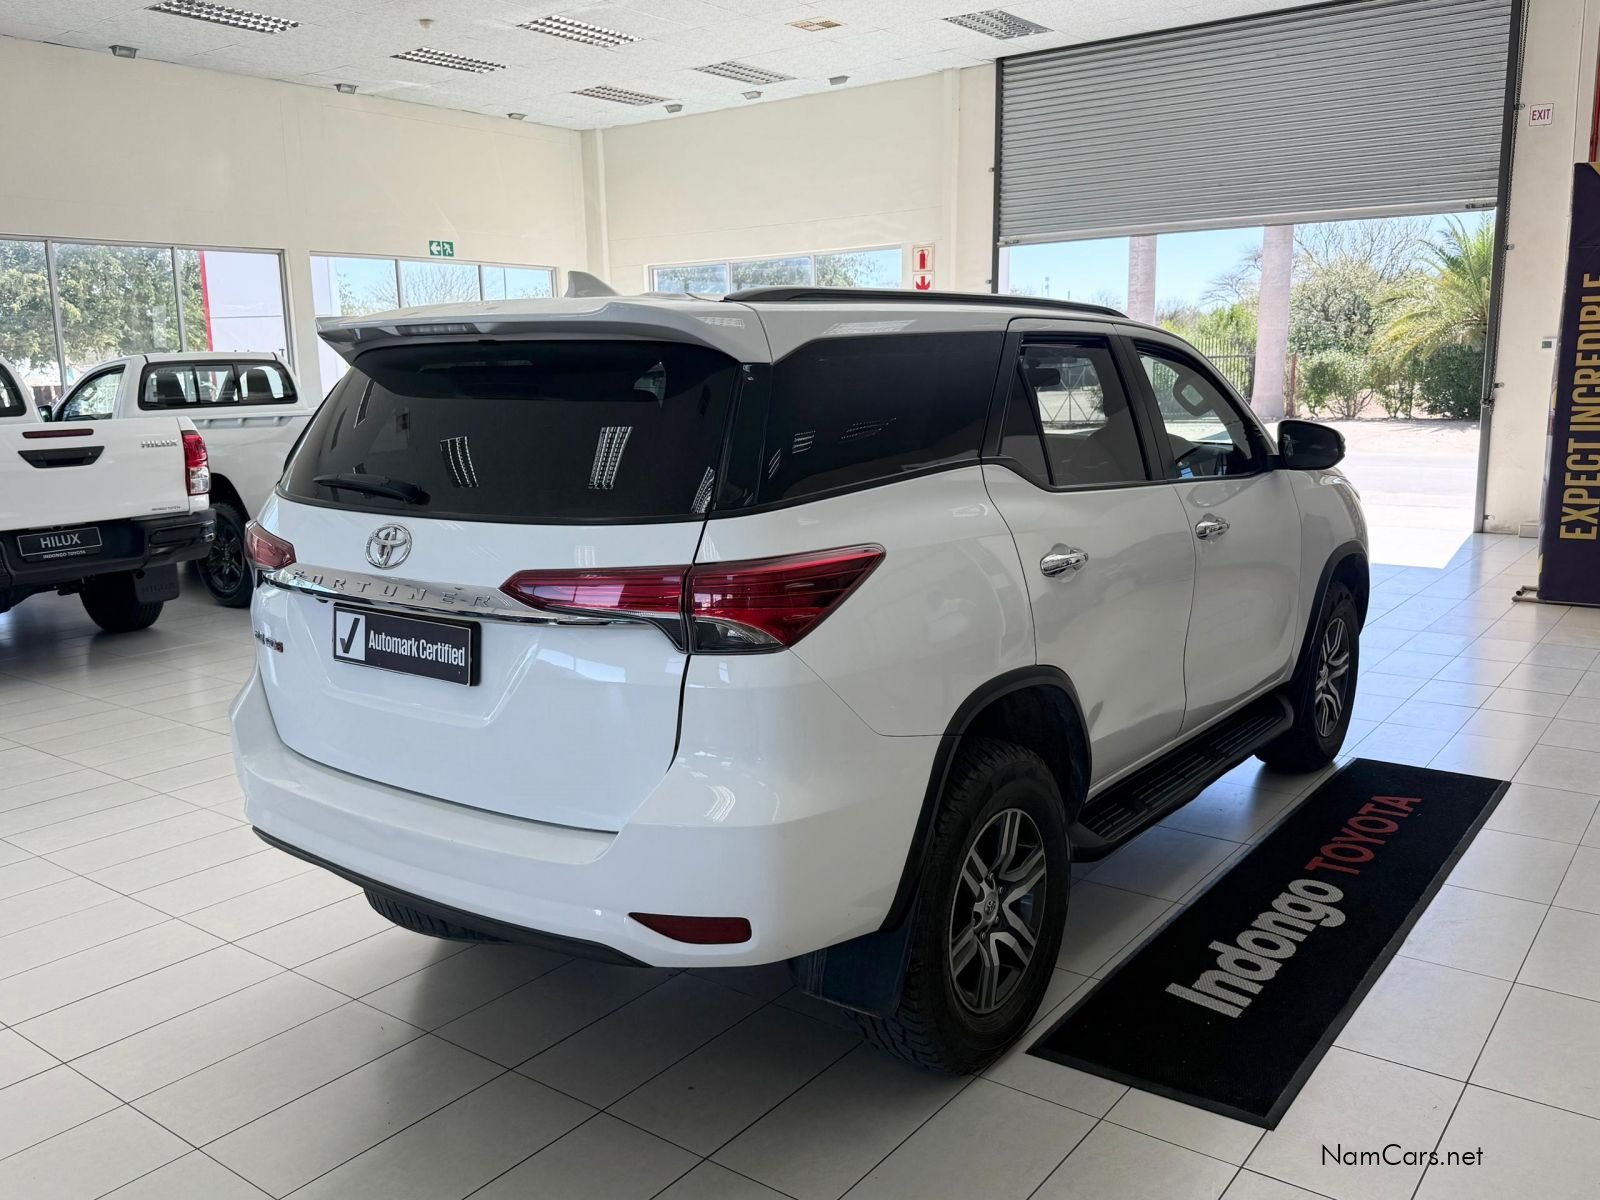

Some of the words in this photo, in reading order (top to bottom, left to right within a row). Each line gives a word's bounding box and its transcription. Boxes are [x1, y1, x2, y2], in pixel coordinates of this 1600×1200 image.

[1531, 109, 1551, 121] EXIT
[1560, 438, 1600, 540] EXPECT
[40, 533, 81, 549] HILUX
[368, 630, 419, 659] Automark
[419, 639, 465, 667] Certified
[1165, 879, 1346, 1018] Indongo
[1304, 795, 1422, 875] TOYOTA
